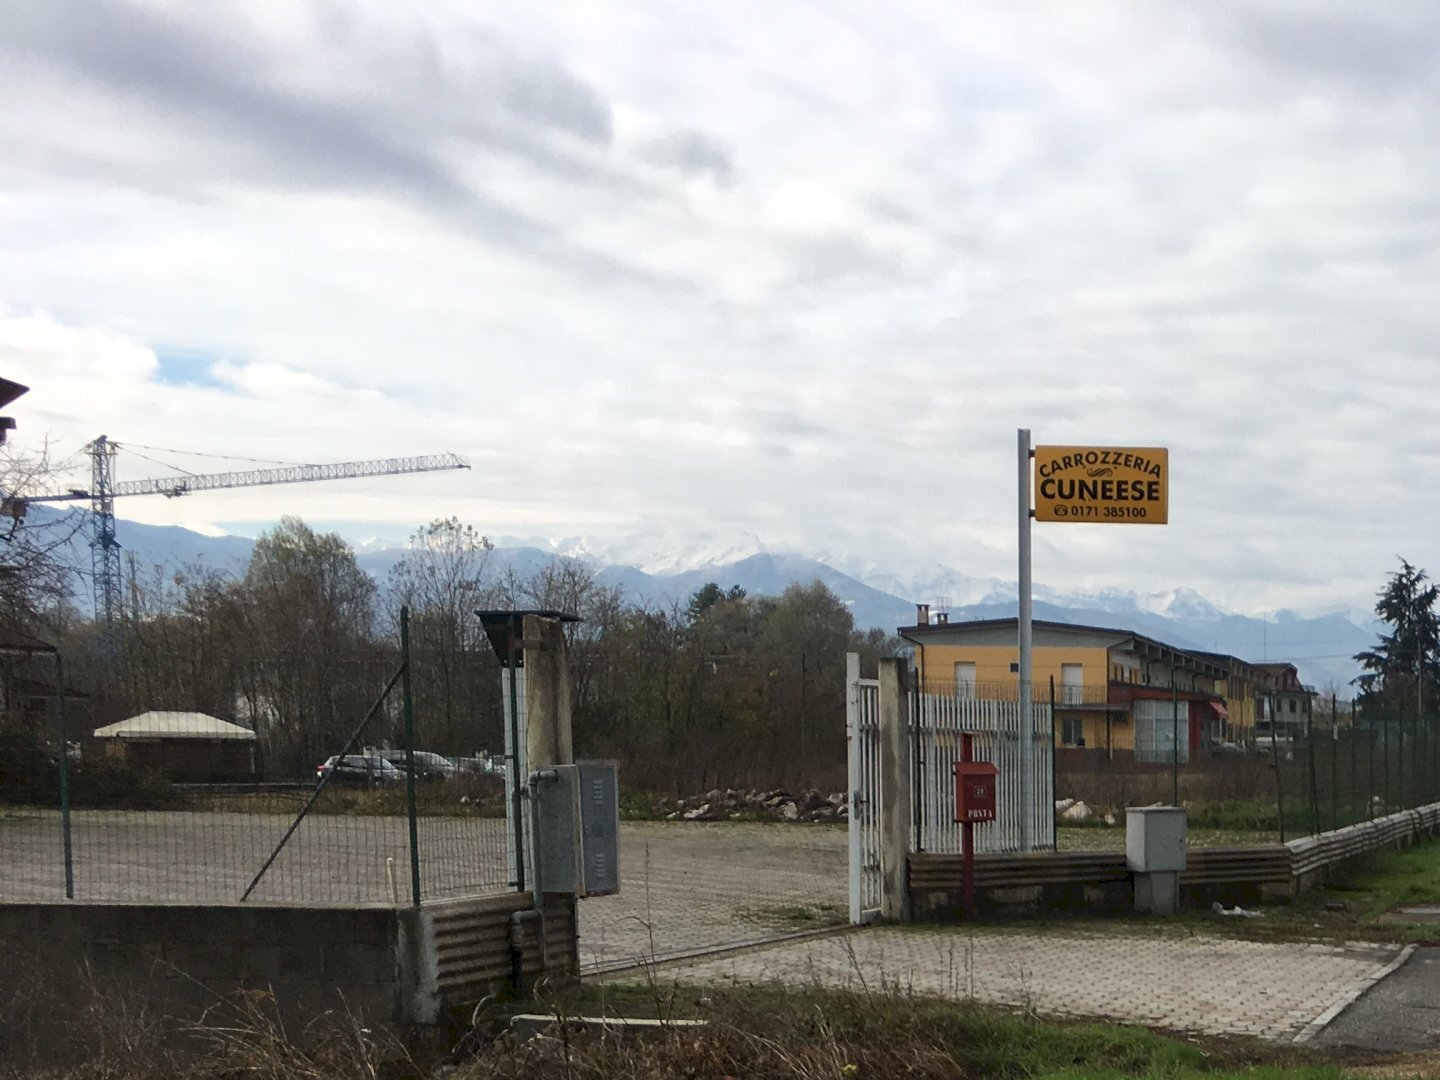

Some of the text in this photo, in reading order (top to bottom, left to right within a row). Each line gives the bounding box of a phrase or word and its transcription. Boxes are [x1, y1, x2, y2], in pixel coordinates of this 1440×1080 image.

[1039, 451, 1161, 478] CARROZZERIA
[1040, 479, 1160, 501] CUNEESE
[1071, 505, 1146, 518] 0171 385100
